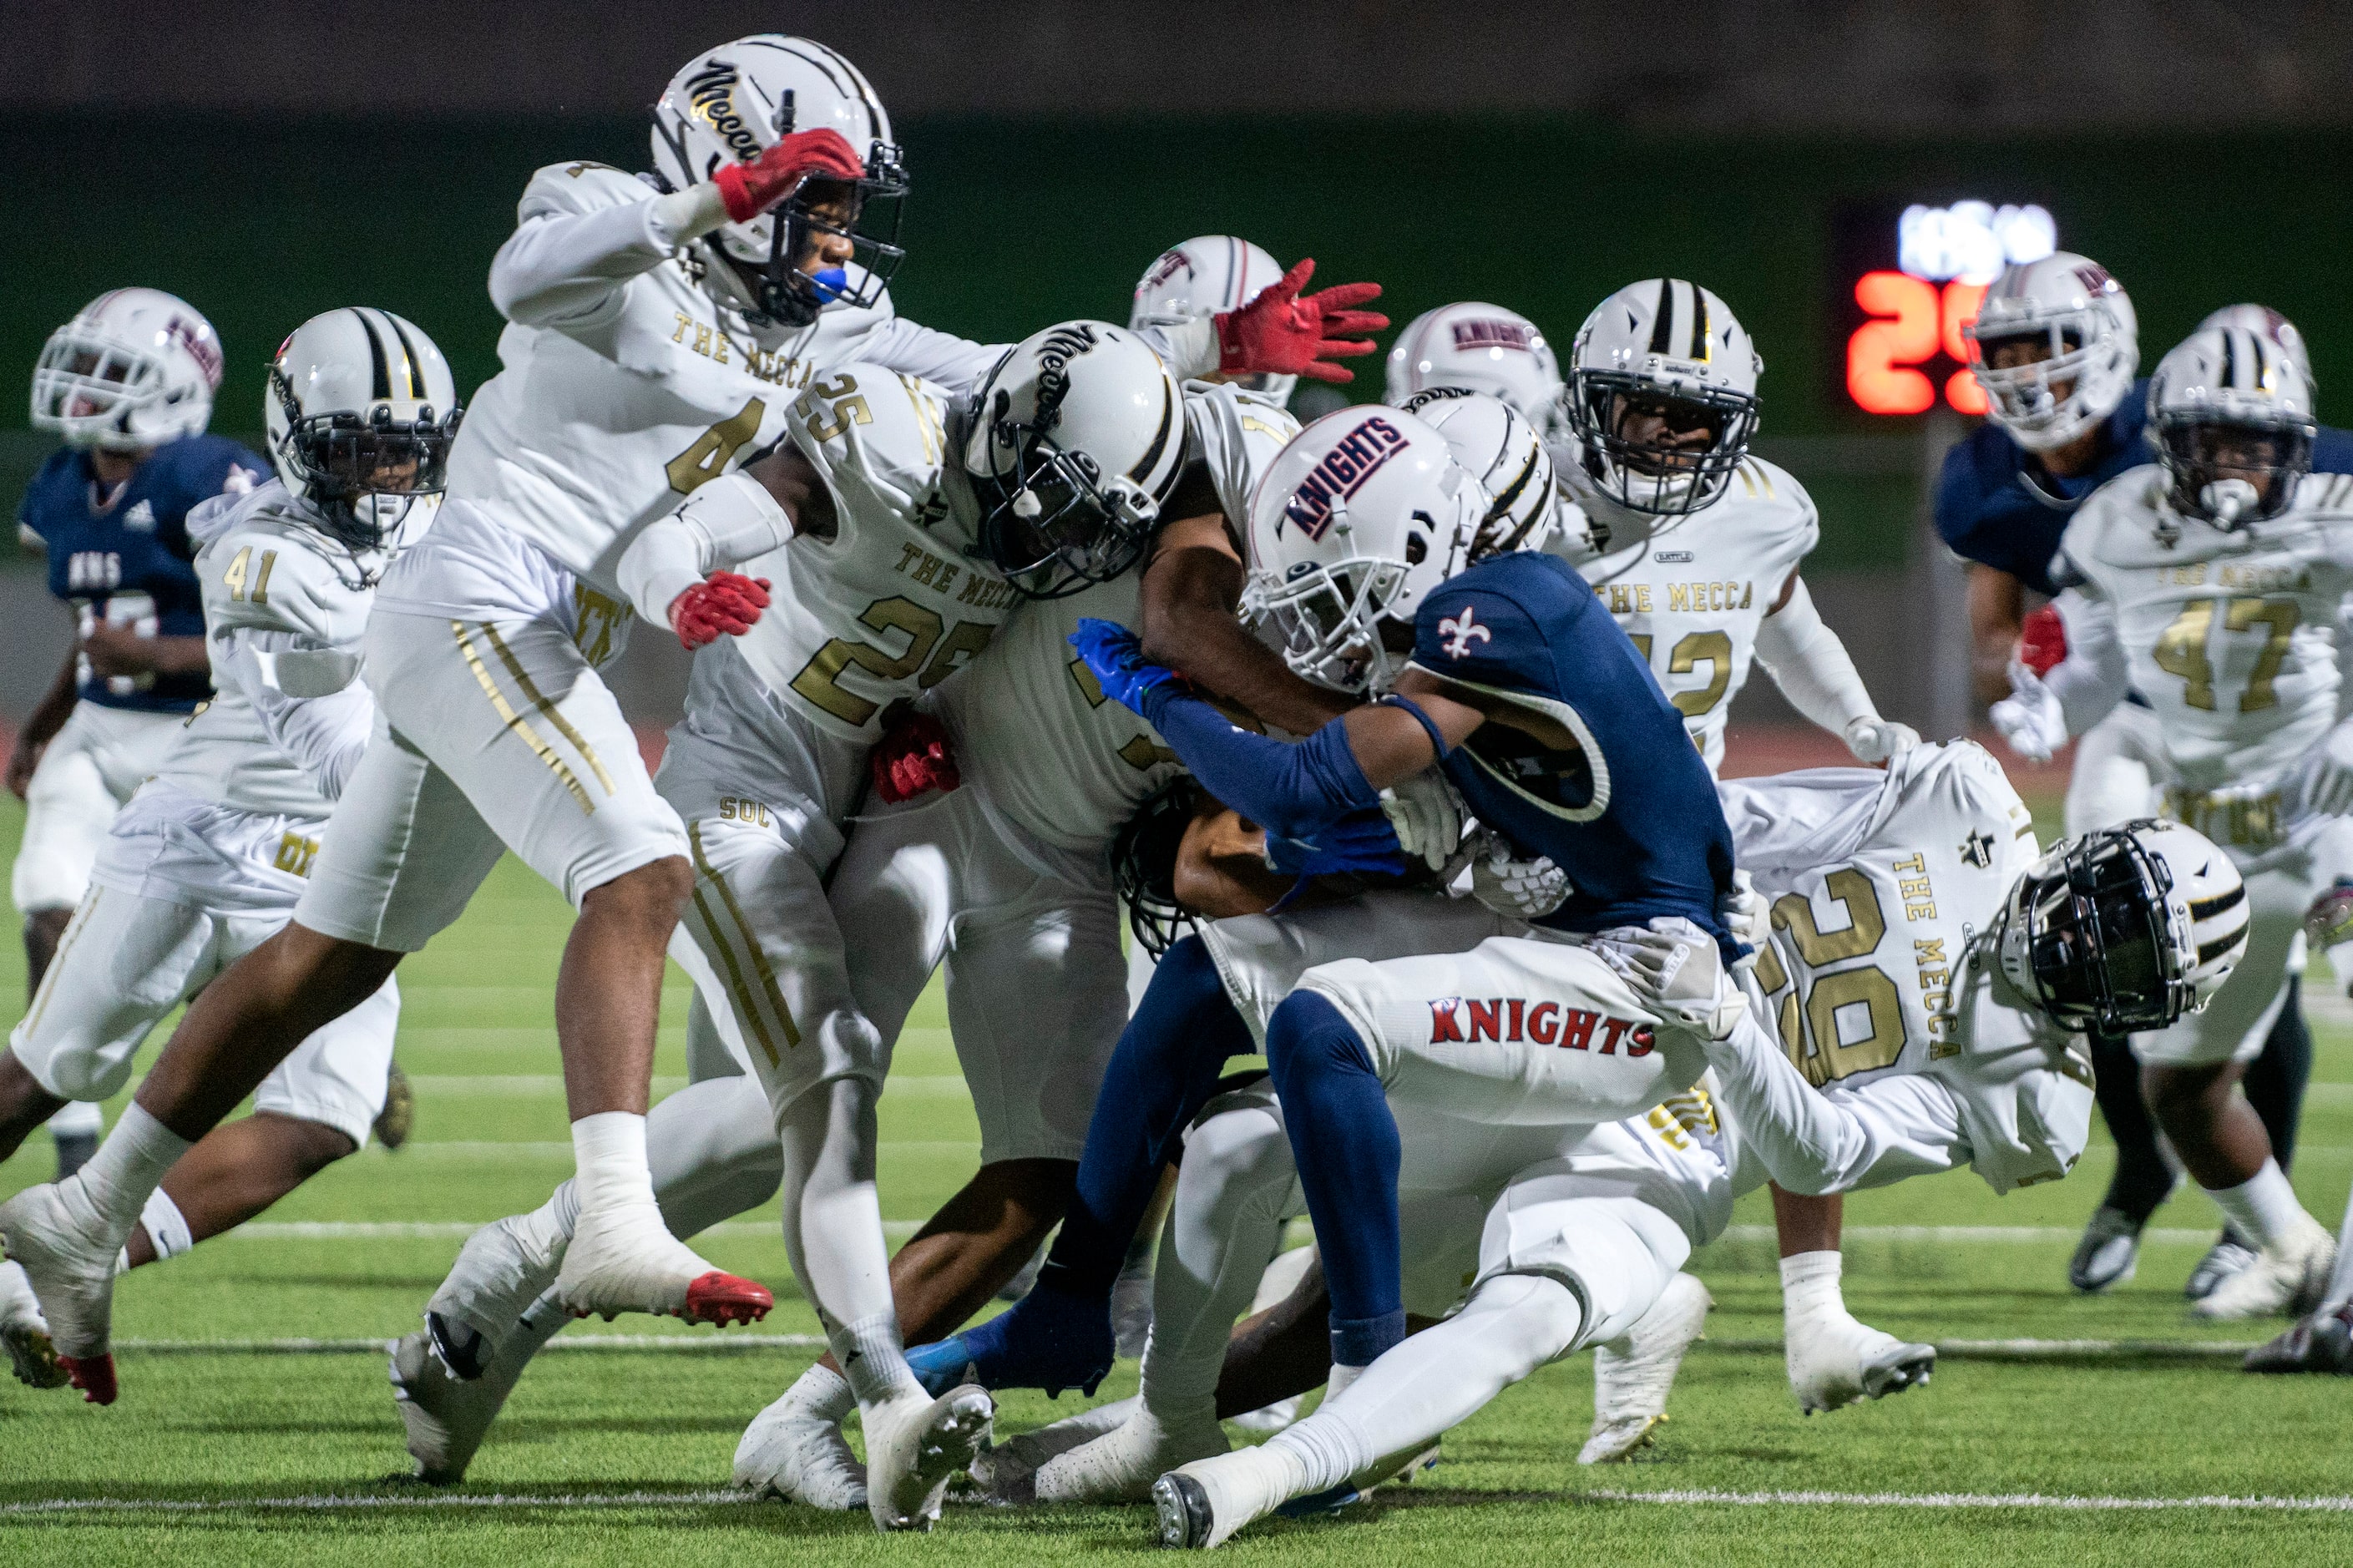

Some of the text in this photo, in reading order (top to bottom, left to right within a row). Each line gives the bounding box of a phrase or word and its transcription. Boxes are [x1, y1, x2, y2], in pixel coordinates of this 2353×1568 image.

[672, 311, 731, 365] THE
[665, 396, 767, 496] 4
[795, 372, 874, 443] 25
[1284, 416, 1404, 537] KNIGHTS
[223, 545, 279, 604] 41
[895, 542, 959, 594] THE
[1667, 581, 1753, 612] MECCA
[1628, 629, 1733, 718] 2
[2152, 598, 2302, 713] 47
[1755, 866, 1908, 1089] 29
[1893, 851, 1961, 1060] THE MECCA
[1428, 997, 1656, 1058] KNIGHTS
